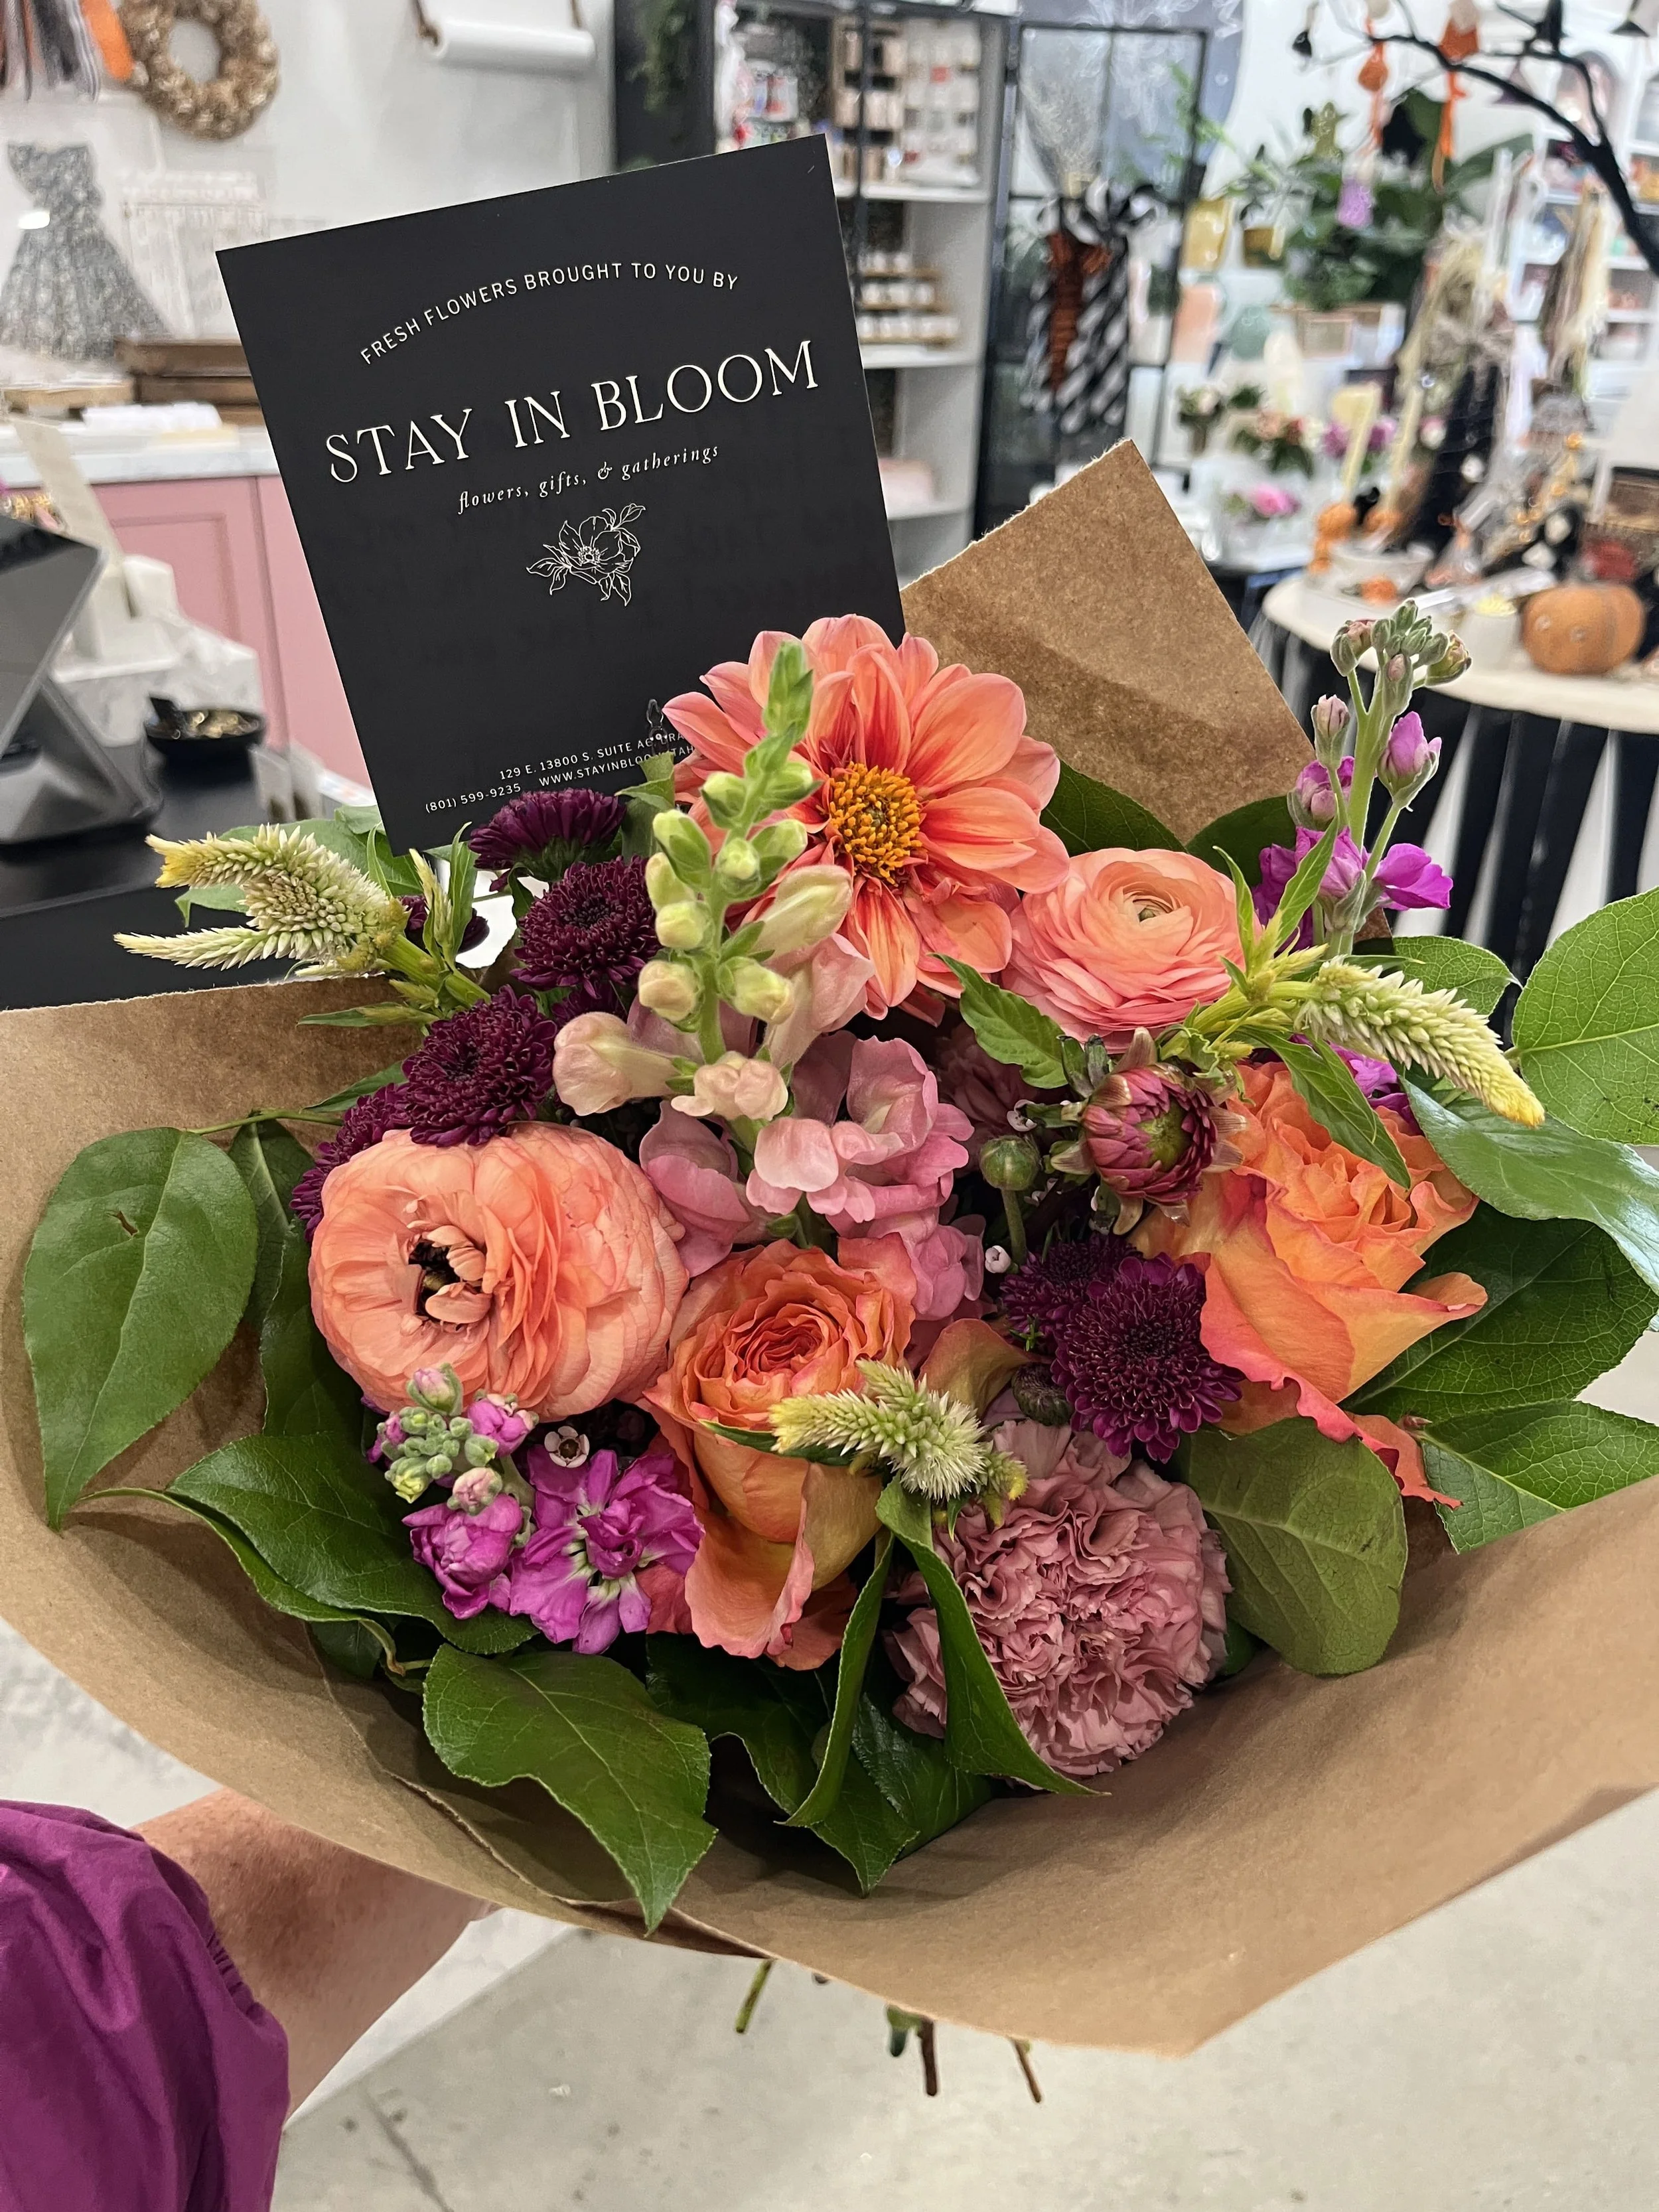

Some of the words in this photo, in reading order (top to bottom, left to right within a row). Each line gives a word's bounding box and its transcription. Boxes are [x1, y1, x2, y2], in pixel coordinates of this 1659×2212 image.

[360, 318, 421, 364] FRESH
[423, 279, 518, 326] FLOWERS
[524, 263, 622, 290] BROUGHT
[630, 262, 656, 279] TO
[665, 264, 704, 284] YOU
[713, 271, 738, 290] BY
[325, 408, 473, 482] STAY
[504, 390, 571, 448] IN
[590, 340, 818, 431] BLOOM
[457, 486, 529, 515] flowers,
[539, 471, 587, 498] gifts,
[597, 461, 613, 480] &
[622, 445, 718, 480] gatherings
[500, 767, 521, 780] 129
[525, 765, 537, 774] E.
[540, 755, 578, 771] 13800
[582, 752, 593, 761] S.
[597, 742, 632, 758] SUITE
[425, 798, 457, 814] (801)
[460, 782, 521, 804] 599-9235
